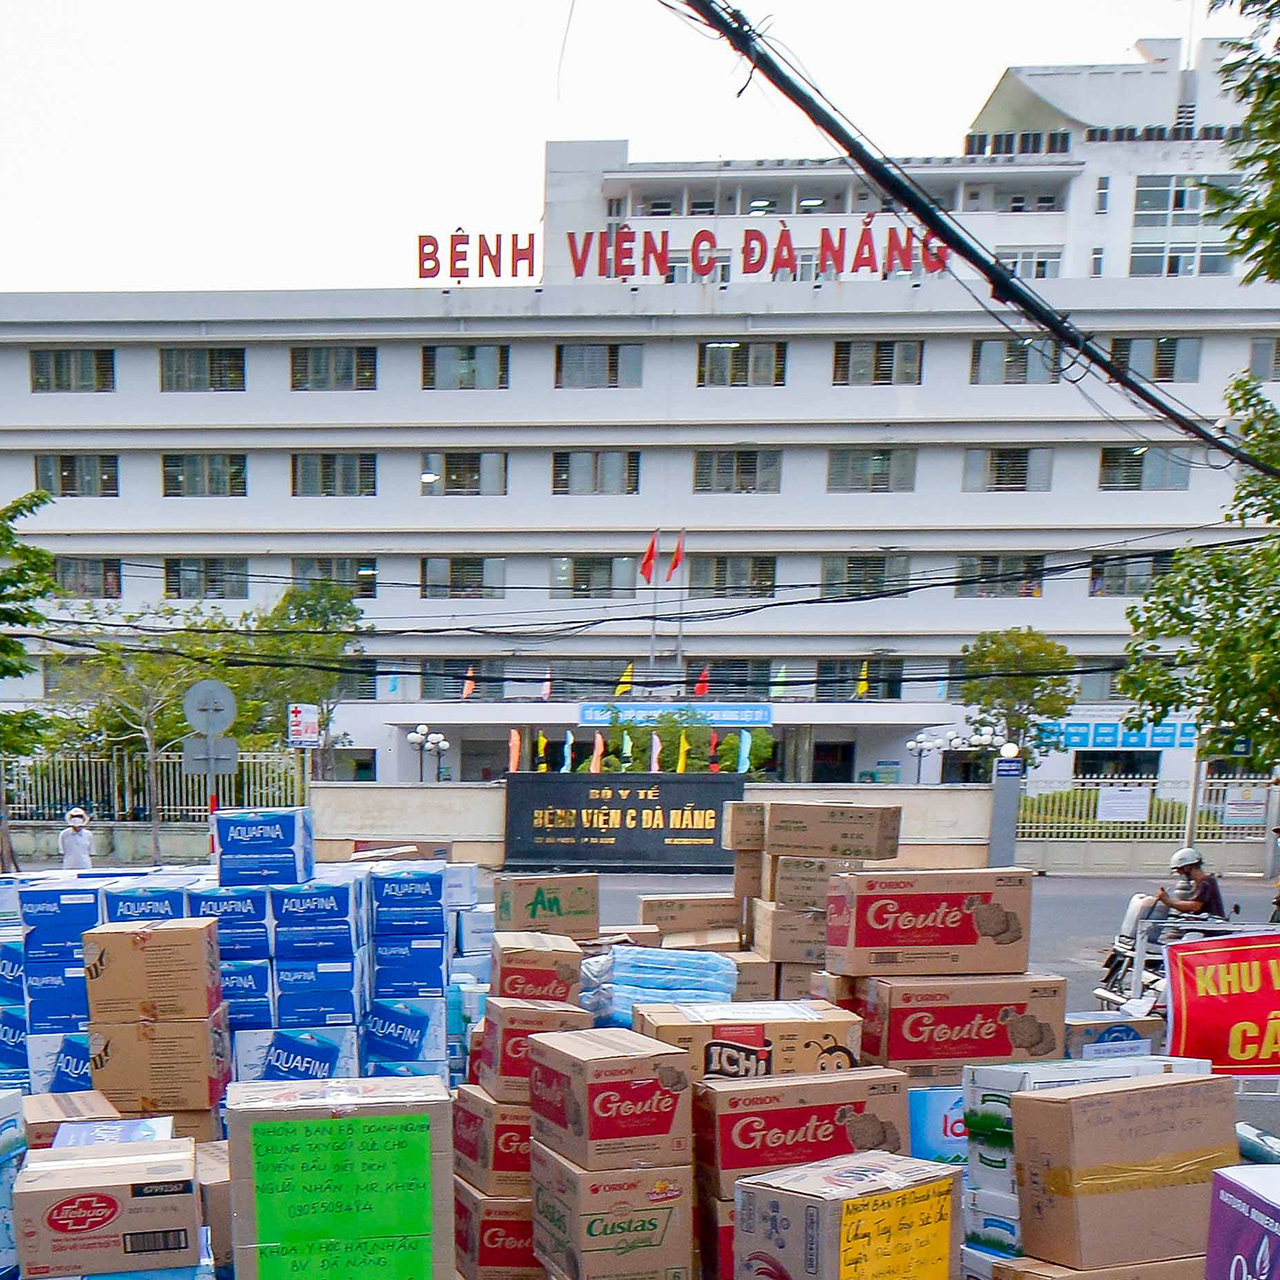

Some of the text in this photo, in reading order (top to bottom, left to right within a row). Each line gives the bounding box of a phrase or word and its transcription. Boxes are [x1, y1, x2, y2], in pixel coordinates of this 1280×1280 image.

[418, 227, 536, 286] BỆNH
[567, 221, 671, 284] VIỆN
[690, 229, 718, 276] C
[741, 219, 798, 275] ĐÀ
[618, 788, 631, 800] Y
[226, 823, 285, 843] AQUAFINA
[533, 805, 577, 833] BỆNH
[581, 805, 622, 834] VIỆN
[625, 809, 637, 830] C
[642, 805, 664, 830] ĐÀ
[382, 881, 433, 898] AQUAFINA
[116, 899, 174, 917] AQUAFINA
[198, 897, 255, 916] AQUAFINA
[281, 895, 339, 914] AQUAFINA
[865, 896, 963, 932] Gouté
[503, 974, 569, 999] Gouté
[1195, 961, 1263, 998] KHU
[901, 1009, 999, 1046] Gouté
[264, 1045, 332, 1080] AQUAFINA
[592, 1088, 674, 1119] Gouté
[731, 1115, 836, 1151] Gouté
[50, 1202, 118, 1227] Lifebuoy
[1219, 1187, 1250, 1219] NATURAL
[586, 1217, 658, 1237] Custas
